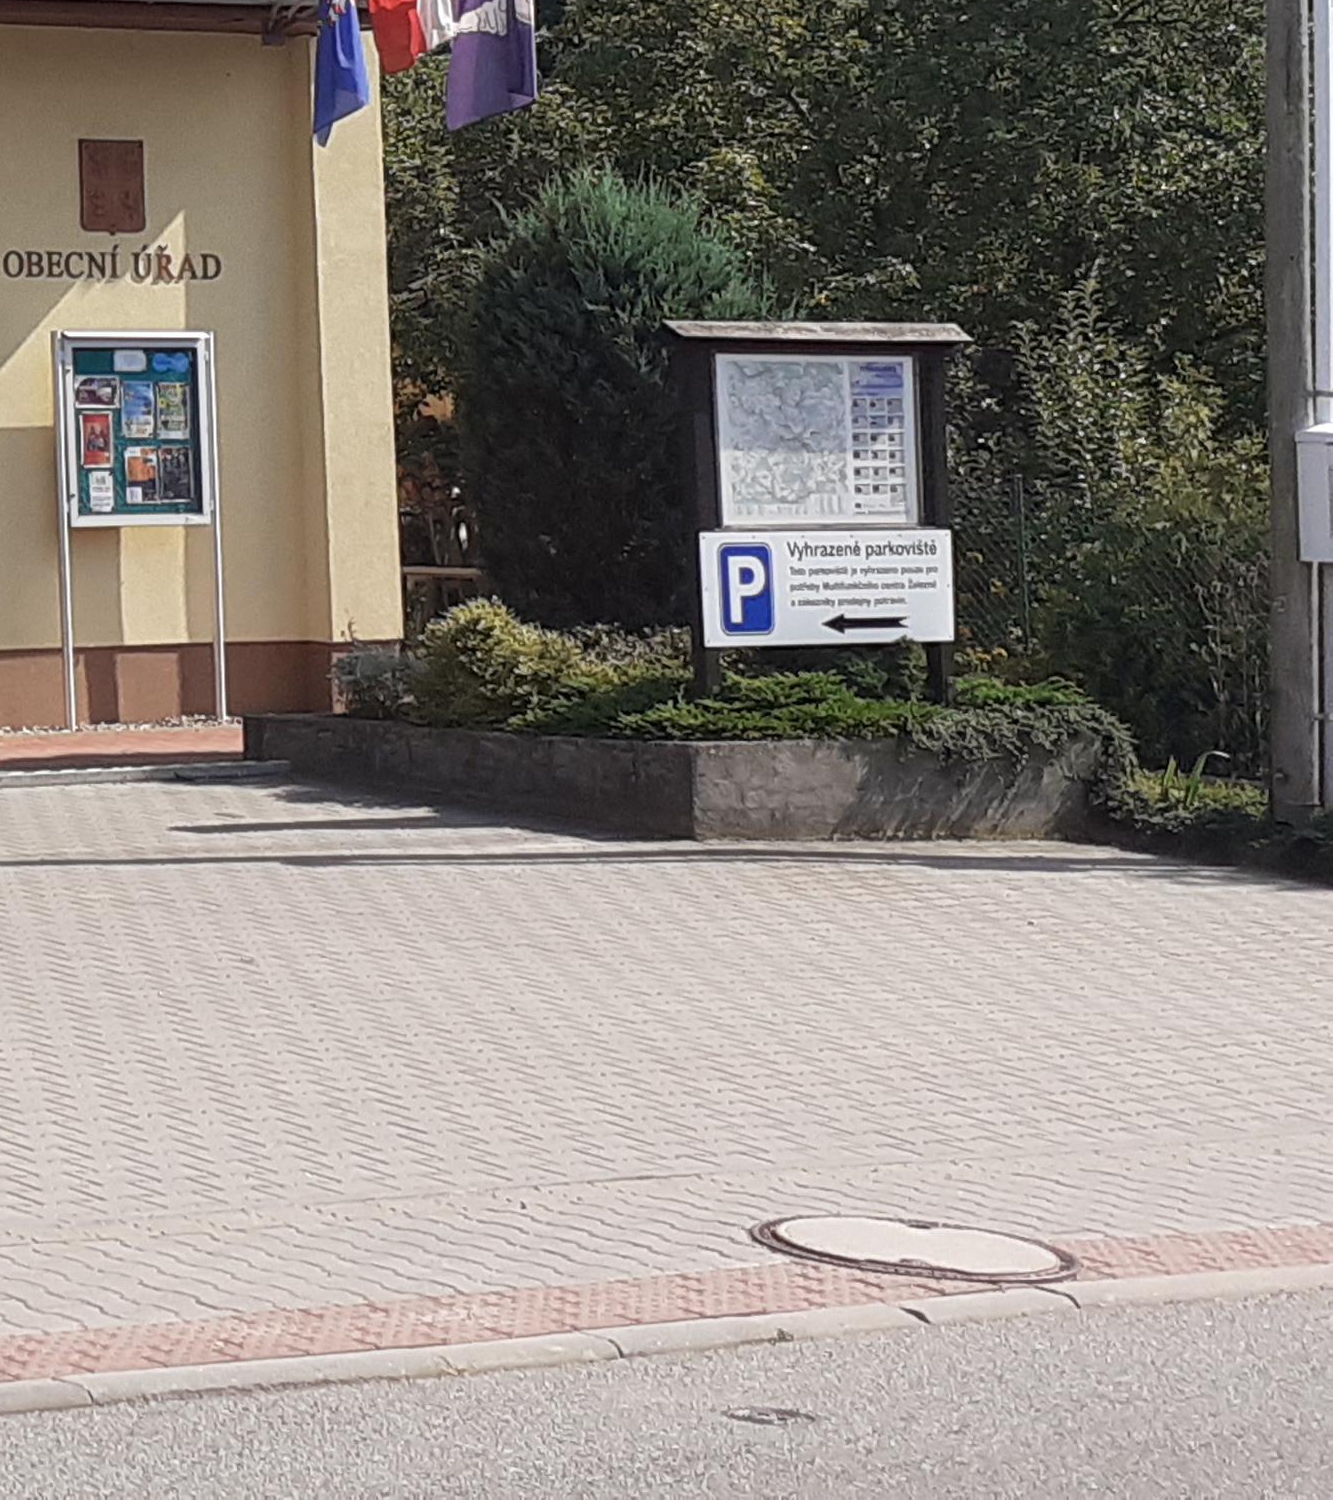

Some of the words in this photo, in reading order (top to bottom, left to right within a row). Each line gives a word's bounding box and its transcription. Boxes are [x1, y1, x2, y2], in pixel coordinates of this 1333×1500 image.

[2, 244, 119, 279] OBECNÍ
[132, 244, 222, 280] ÚŘAD
[786, 541, 861, 561] Vyhrazené
[865, 539, 938, 560] parkoviště
[789, 566, 806, 576] Toto
[808, 566, 848, 577] parkoviště
[860, 565, 899, 577] vyhrazeno
[901, 566, 924, 576] pouze
[926, 566, 939, 576] pro
[727, 555, 766, 624] P
[789, 581, 820, 592] potřeby
[881, 581, 906, 590] centra
